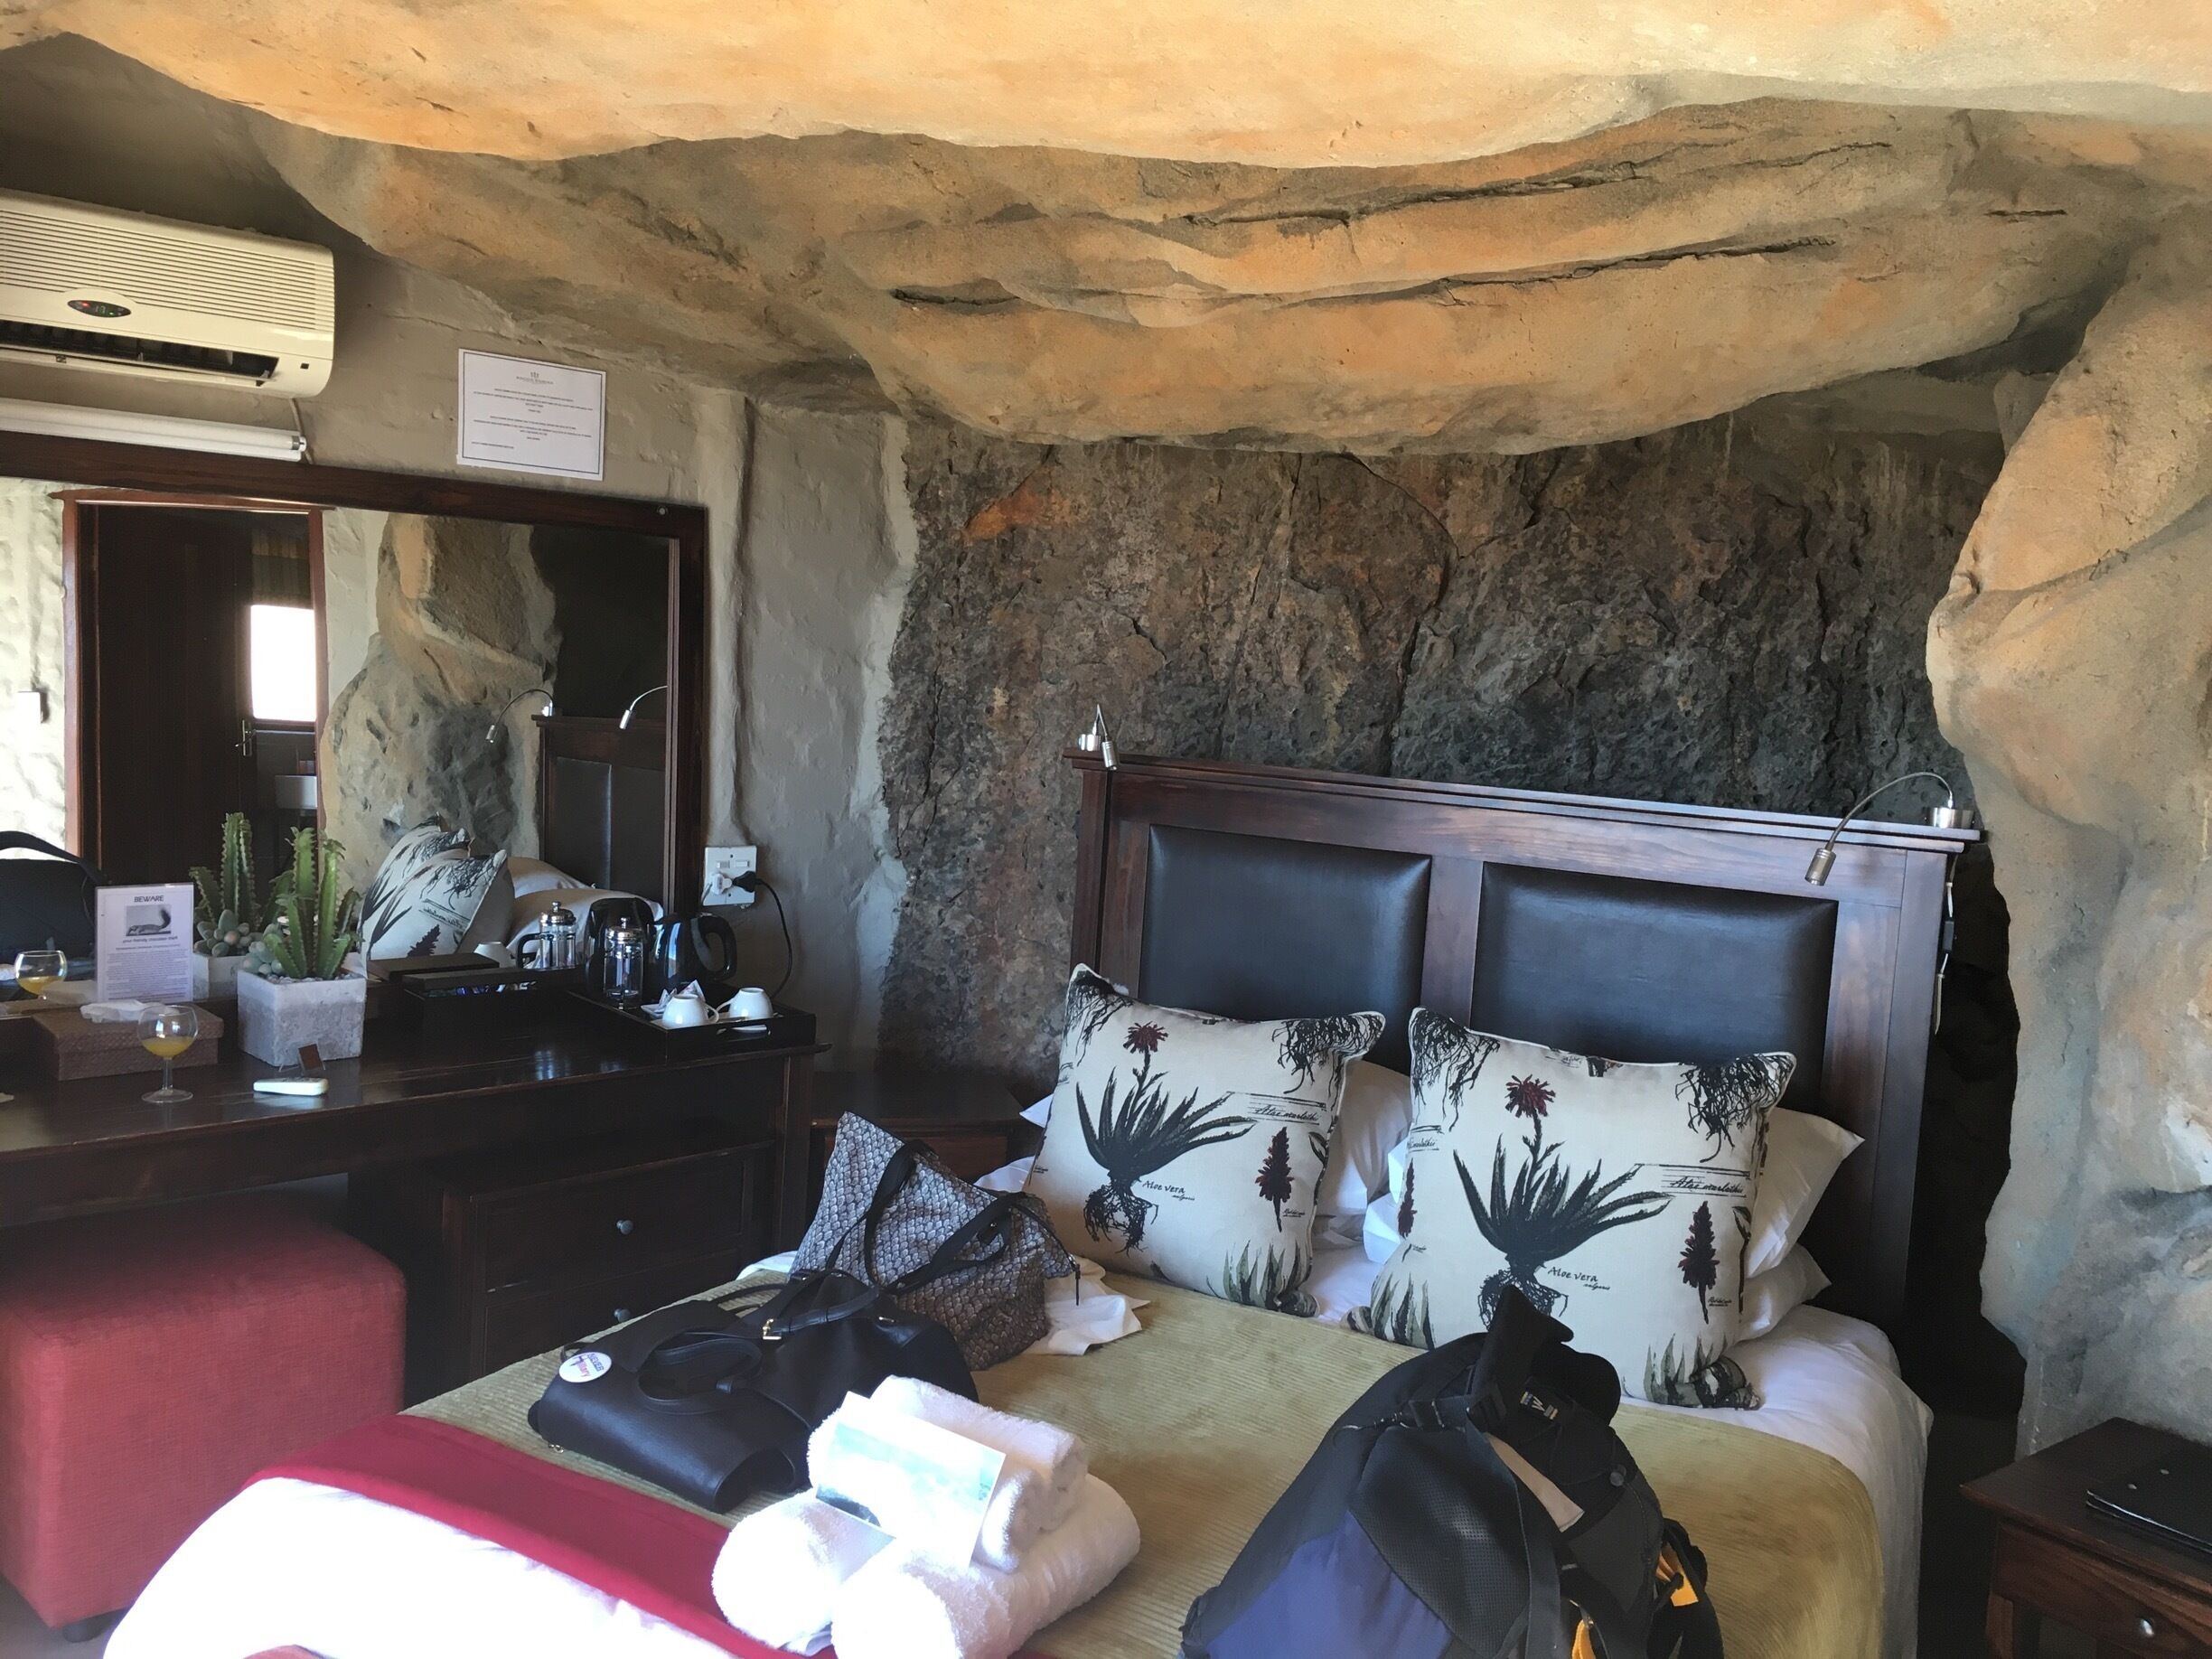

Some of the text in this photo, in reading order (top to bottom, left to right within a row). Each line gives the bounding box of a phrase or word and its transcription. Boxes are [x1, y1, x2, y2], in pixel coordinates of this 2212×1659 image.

[134, 895, 164, 903] BEWARE
[1142, 1180, 1186, 1194] Aloe vera
[1547, 1266, 1598, 1282] Aloe vera
